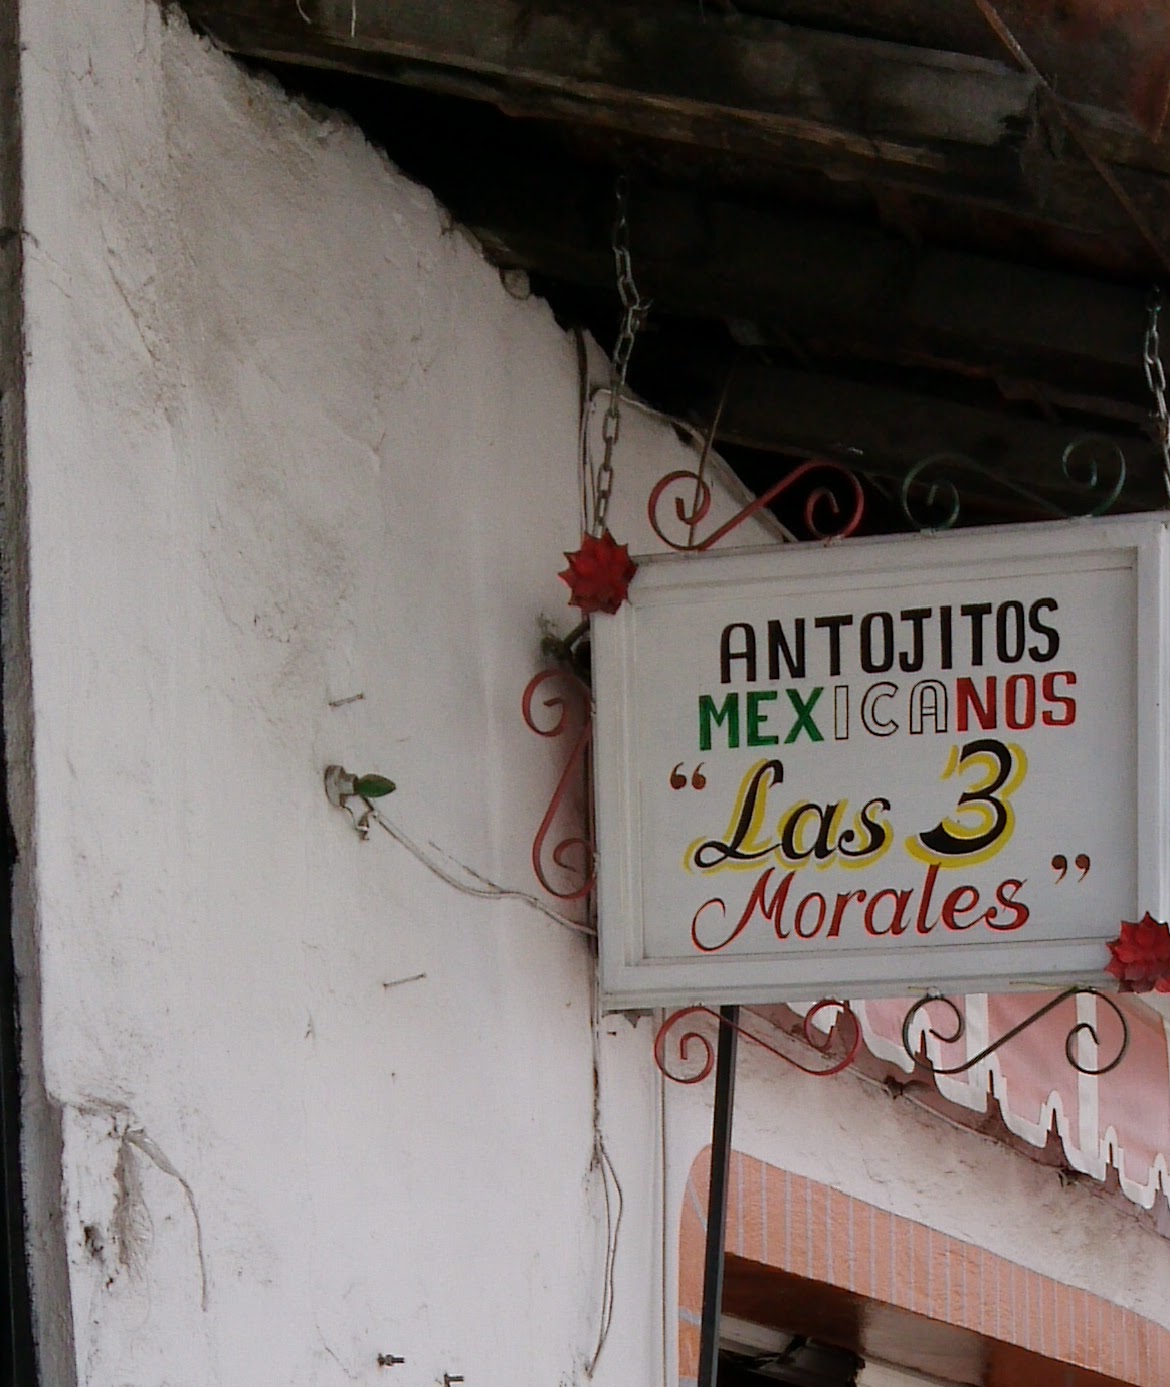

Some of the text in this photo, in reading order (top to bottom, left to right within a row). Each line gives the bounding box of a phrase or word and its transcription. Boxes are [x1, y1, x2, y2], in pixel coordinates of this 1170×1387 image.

[720, 597, 1060, 684] ANTOJITOS
[698, 671, 1078, 751] MEXICANOS
[905, 738, 1029, 868] 3
